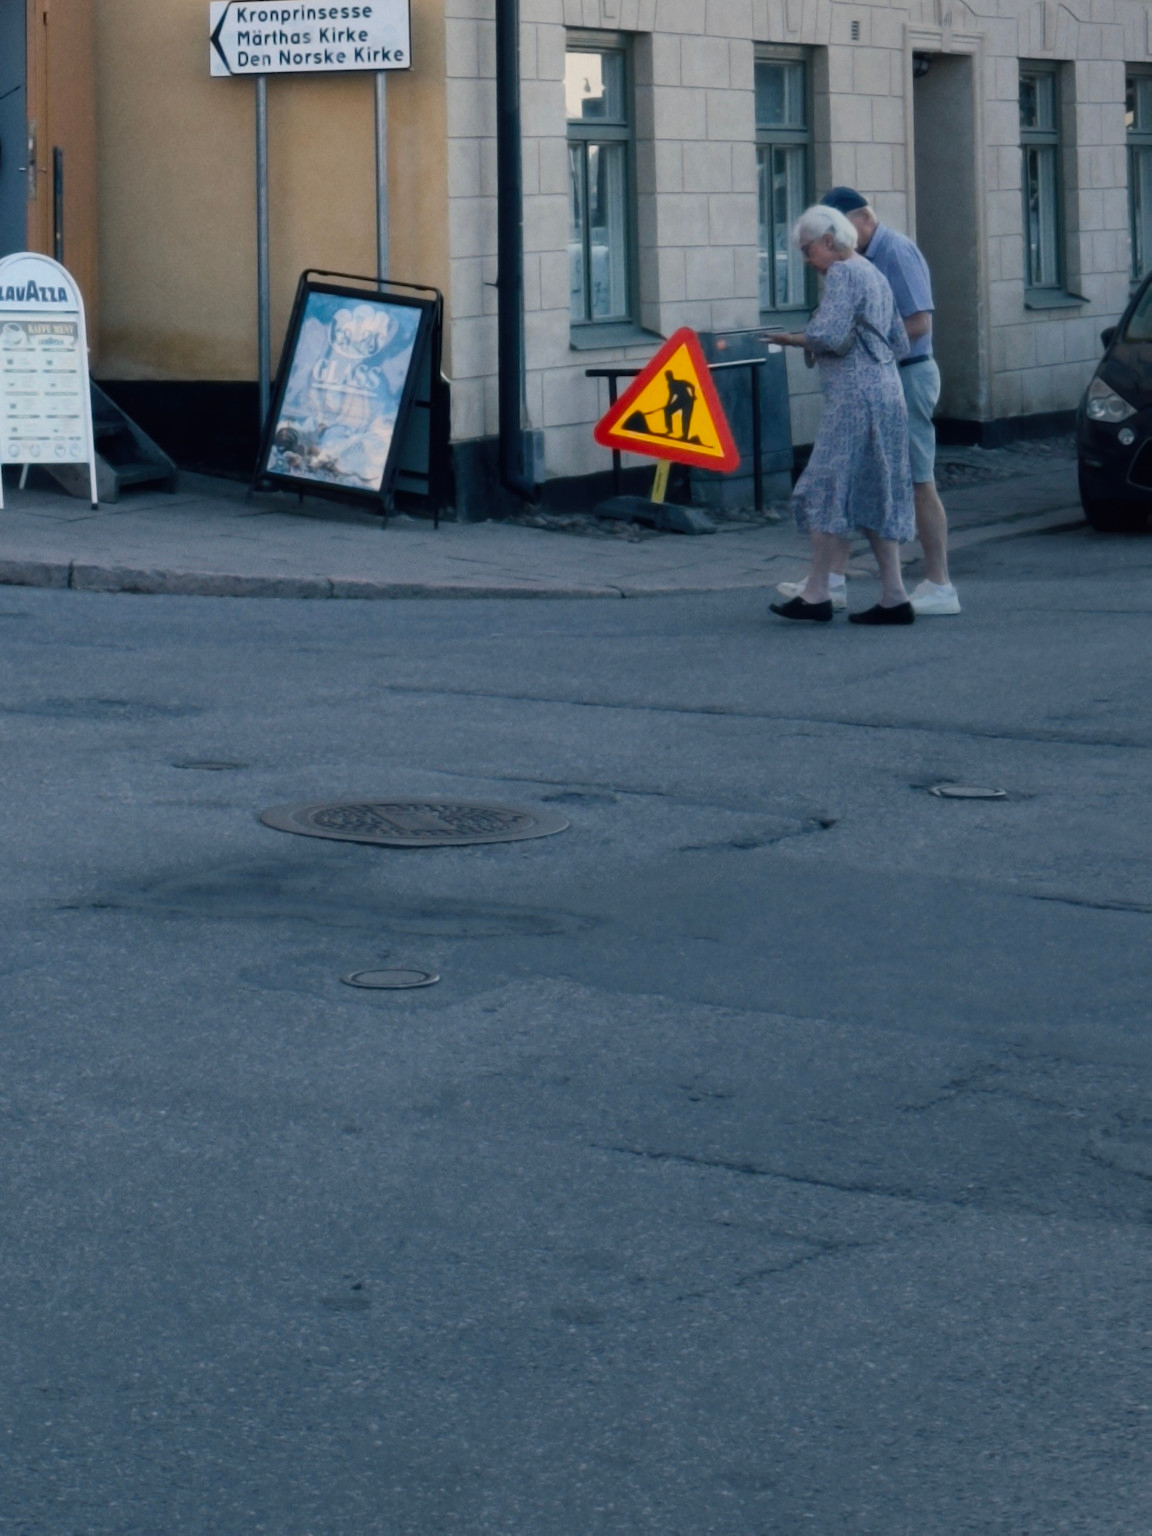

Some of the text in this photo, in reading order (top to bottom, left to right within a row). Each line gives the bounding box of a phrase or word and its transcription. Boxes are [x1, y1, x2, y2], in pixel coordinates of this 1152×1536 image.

[236, 4, 373, 24] Kronprinsesse
[236, 27, 369, 47] Märthas Kirke
[237, 46, 404, 67] Den Norske Kirke
[313, 358, 382, 389] GLASS
